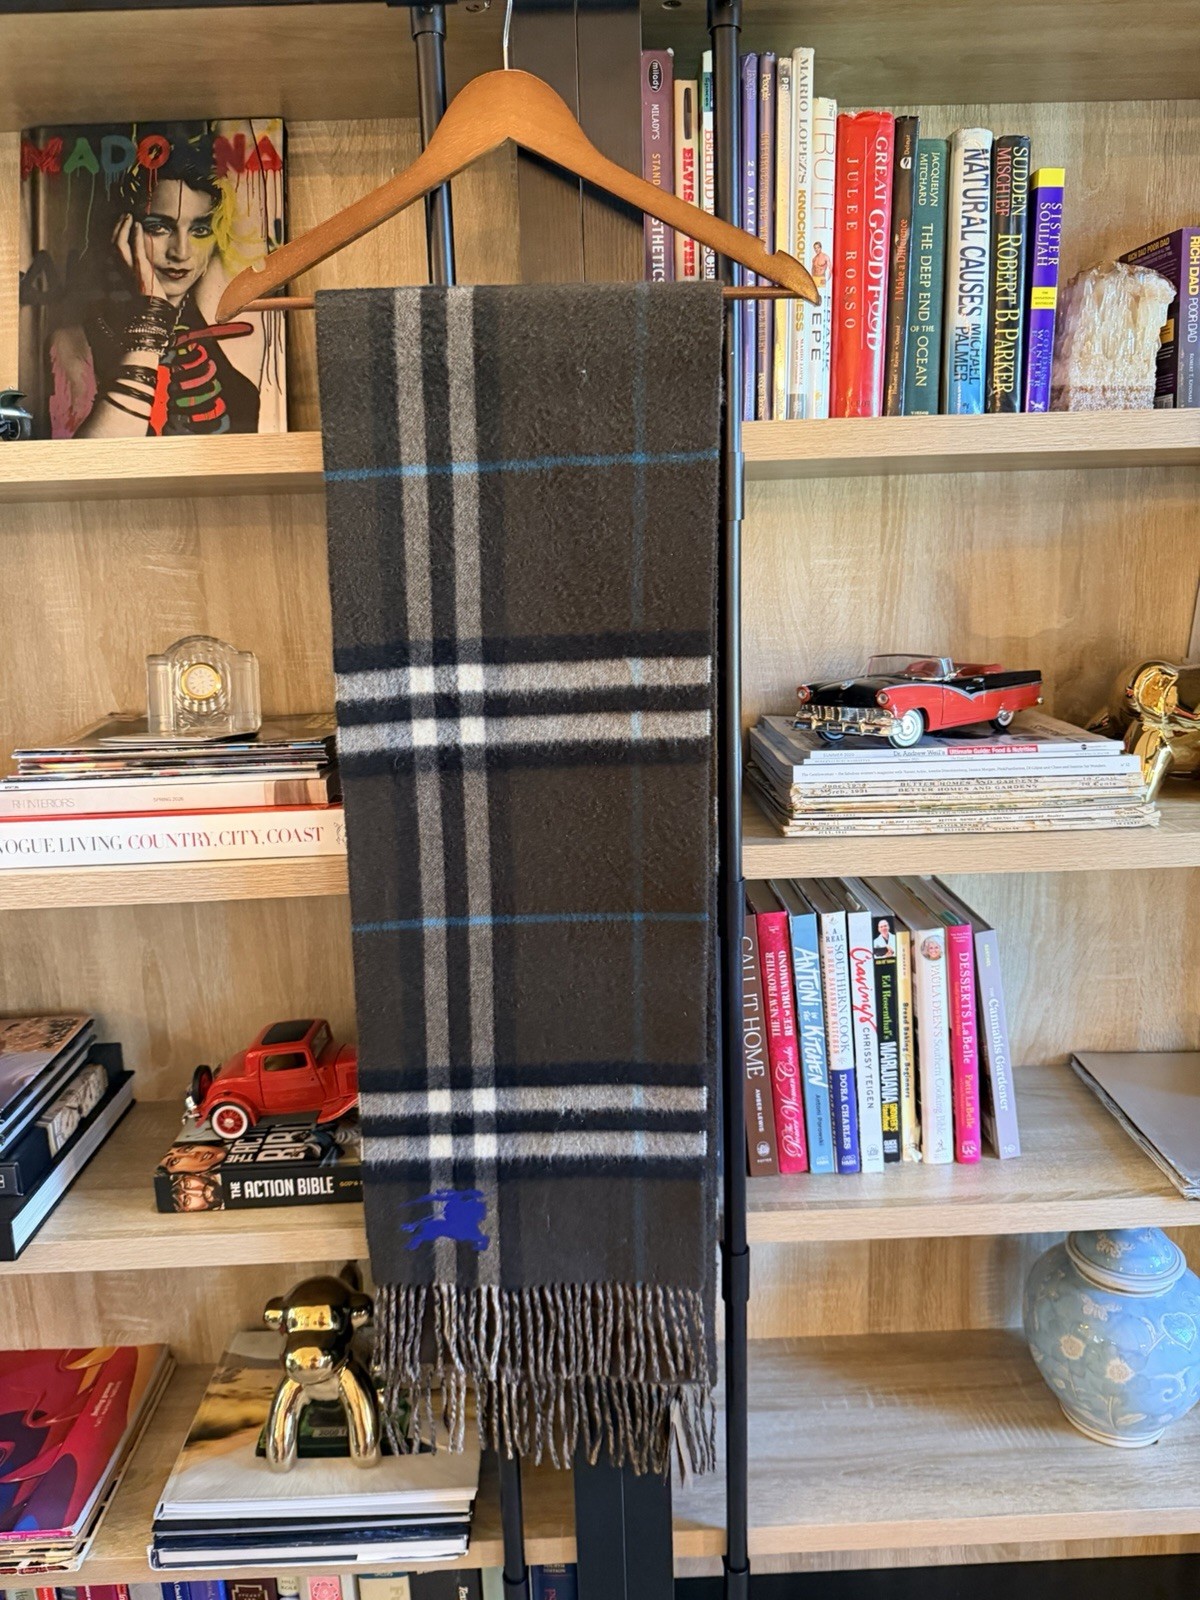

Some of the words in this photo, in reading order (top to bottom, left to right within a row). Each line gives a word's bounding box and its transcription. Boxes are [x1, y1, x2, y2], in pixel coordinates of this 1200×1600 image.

[762, 73, 771, 101] People
[799, 58, 809, 112] MARIO
[651, 104, 660, 140] MILADY'S
[20, 133, 283, 182] MADONA
[652, 153, 661, 186] STAND
[747, 160, 755, 177] 25
[798, 119, 809, 184] LOPEZ'S
[874, 136, 888, 205] GREAT
[682, 147, 694, 203] ELVIS
[813, 118, 835, 230] TRUTH
[846, 157, 859, 231] JULEE
[918, 153, 928, 206] MITCHARD
[930, 152, 940, 207] JACQUELYN
[996, 147, 1012, 217] MISCHIEF
[1011, 146, 1028, 216] SUDDEN
[746, 186, 755, 234] AMAZI
[960, 148, 989, 241] NATURAL
[867, 208, 887, 279] GOOD
[896, 218, 908, 263] Difference
[921, 222, 934, 250] THE
[1037, 202, 1051, 267] SOULJAH
[1048, 202, 1063, 266] SISTER
[1189, 235, 1200, 265] RICH
[684, 238, 695, 277] THE
[919, 255, 932, 288] DEEP
[996, 233, 1022, 305] ROBERT
[844, 250, 857, 329] ROSSO
[895, 277, 906, 297] Make
[957, 245, 987, 317] CAUSES
[1188, 267, 1200, 296] DAD
[866, 284, 884, 351] FOOD
[918, 292, 931, 322] END
[995, 308, 1020, 325] B.
[1187, 298, 1198, 323] POOR
[810, 312, 822, 361] EPE
[910, 325, 920, 333] OF
[921, 325, 936, 333] THE
[1187, 324, 1197, 343] DAD
[915, 335, 929, 387] OCEAN
[953, 326, 970, 383] PALMER
[968, 323, 982, 385] MICHAEL
[993, 328, 1019, 394] PARKER
[1034, 329, 1045, 387] WINTER
[893, 749, 901, 757] Dr.
[902, 749, 926, 757] Andrew
[927, 748, 946, 757] Weil's
[1012, 745, 1037, 753] Nutrition
[23, 797, 75, 809] INTERIORS
[59, 835, 122, 853] LIVING
[267, 826, 324, 844] COAST
[825, 935, 844, 943] REAL
[765, 951, 778, 998] FRONTIER
[778, 950, 791, 1009] DRUMMOND
[834, 944, 848, 1014] SOUTHERN
[849, 947, 878, 1032] Cravings
[881, 975, 891, 988] Ed
[931, 965, 941, 998] PAULA
[959, 952, 972, 1018] DESSERTS
[743, 993, 759, 1012] IT
[769, 997, 780, 1018] NEW
[828, 978, 838, 1017] SAVANNAH
[882, 990, 893, 1040] Rosenthal's
[771, 1018, 782, 1038] THE
[784, 1016, 795, 1037] REE
[830, 1018, 840, 1054] KITCHEN
[838, 1015, 850, 1053] COOK
[932, 1000, 942, 1037] DEEN'S
[988, 998, 1004, 1054] Cannabis
[743, 1016, 765, 1079] HOME
[862, 1027, 872, 1069] CHRISSY
[933, 1039, 943, 1076] Southern
[962, 1021, 975, 1065] LaBelle
[774, 1045, 797, 1082] Cooks
[880, 1041, 899, 1104] MARIJUANA
[965, 1074, 974, 1093] Patti
[994, 1055, 1009, 1112] Gardener
[755, 1088, 763, 1111] AMBER
[776, 1078, 800, 1120] Woman
[839, 1073, 849, 1102] DORA
[865, 1074, 875, 1109] TEIGEN
[932, 1078, 945, 1114] Cooking
[757, 1112, 765, 1133] LEWIS
[841, 1104, 853, 1150] CHARLES
[965, 1093, 976, 1129] LaBelle
[781, 1119, 803, 1158] Pioneer
[230, 1181, 241, 1199] THE
[243, 1178, 294, 1199] ACTION
[296, 1176, 335, 1196] BIBLE
